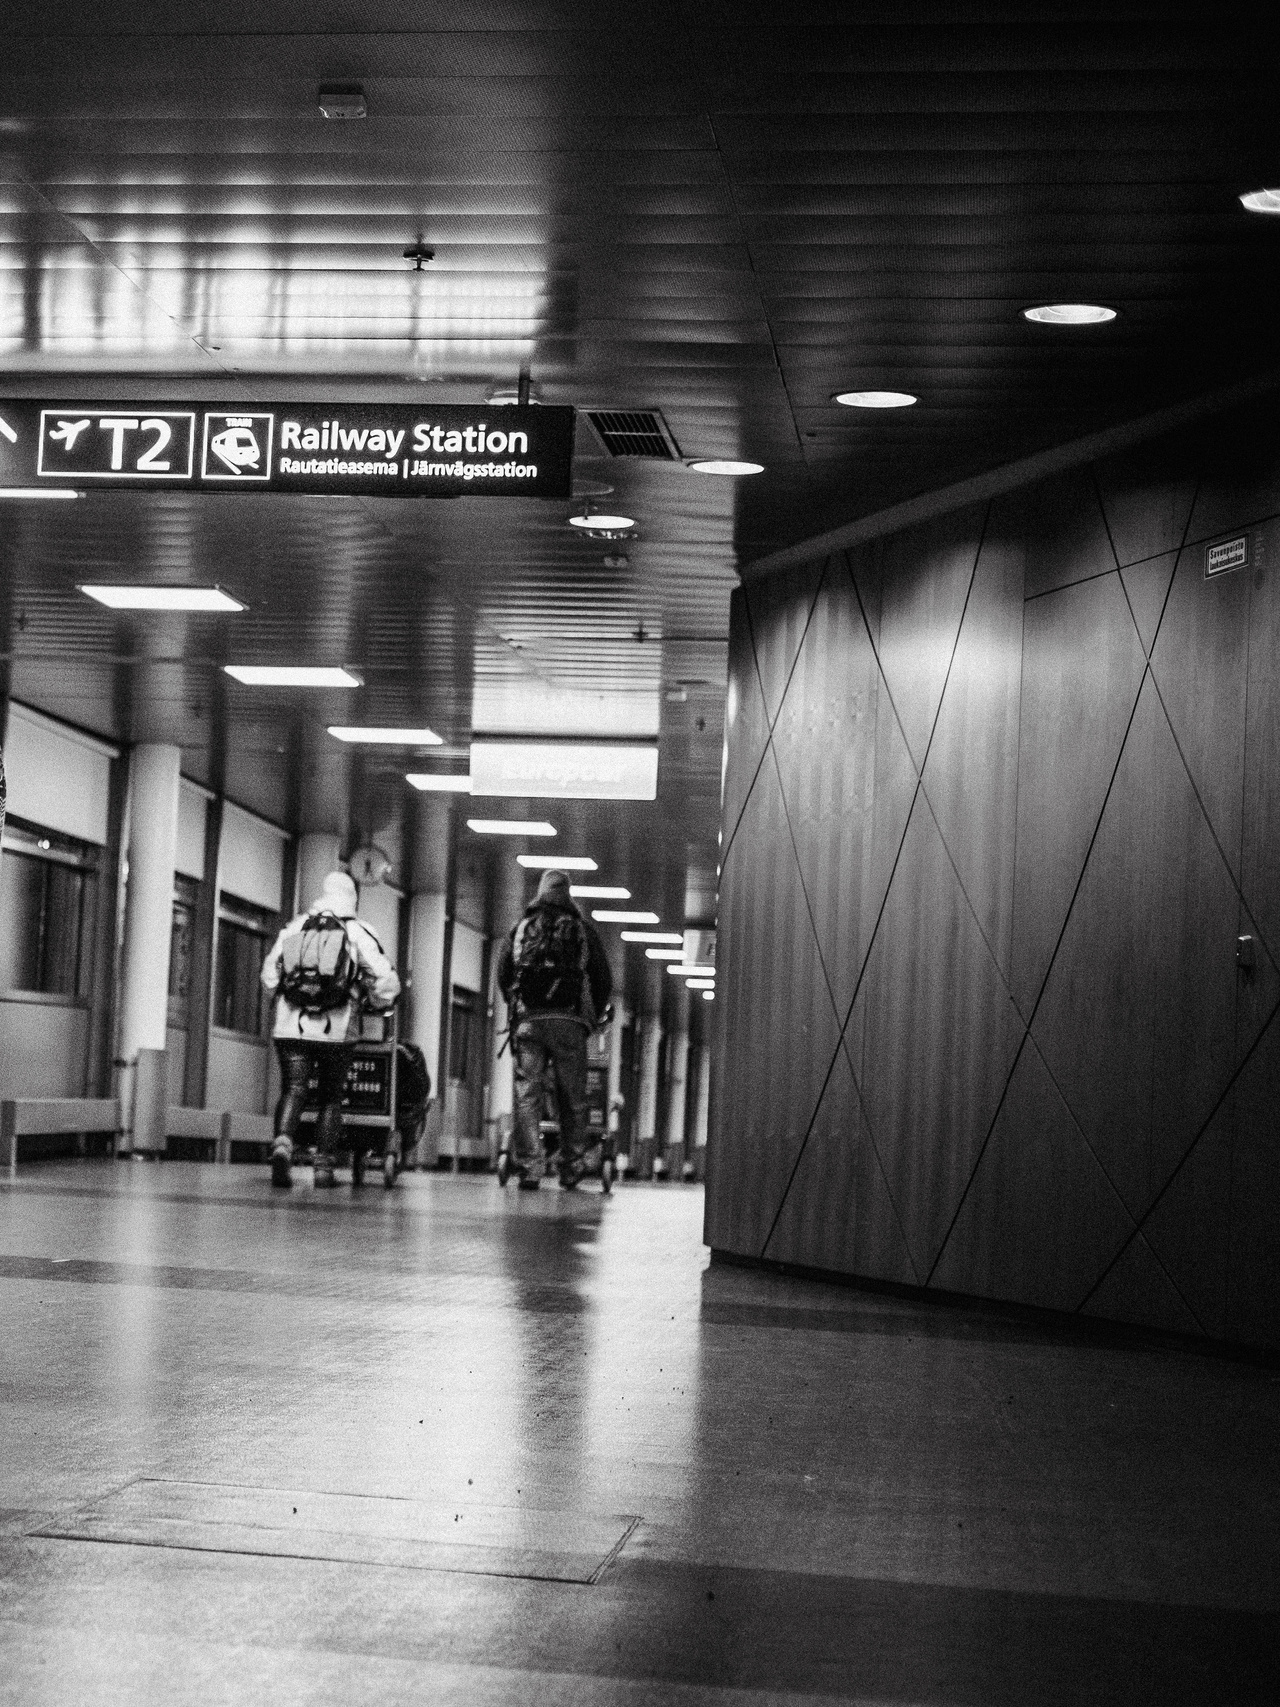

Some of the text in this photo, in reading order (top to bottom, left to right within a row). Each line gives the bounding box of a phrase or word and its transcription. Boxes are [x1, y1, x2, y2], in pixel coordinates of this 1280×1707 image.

[225, 417, 253, 428] TRAIN
[98, 418, 172, 471] T2
[280, 420, 529, 459] Railway Station
[279, 456, 538, 481] Rautatieasema Järnvägsstation
